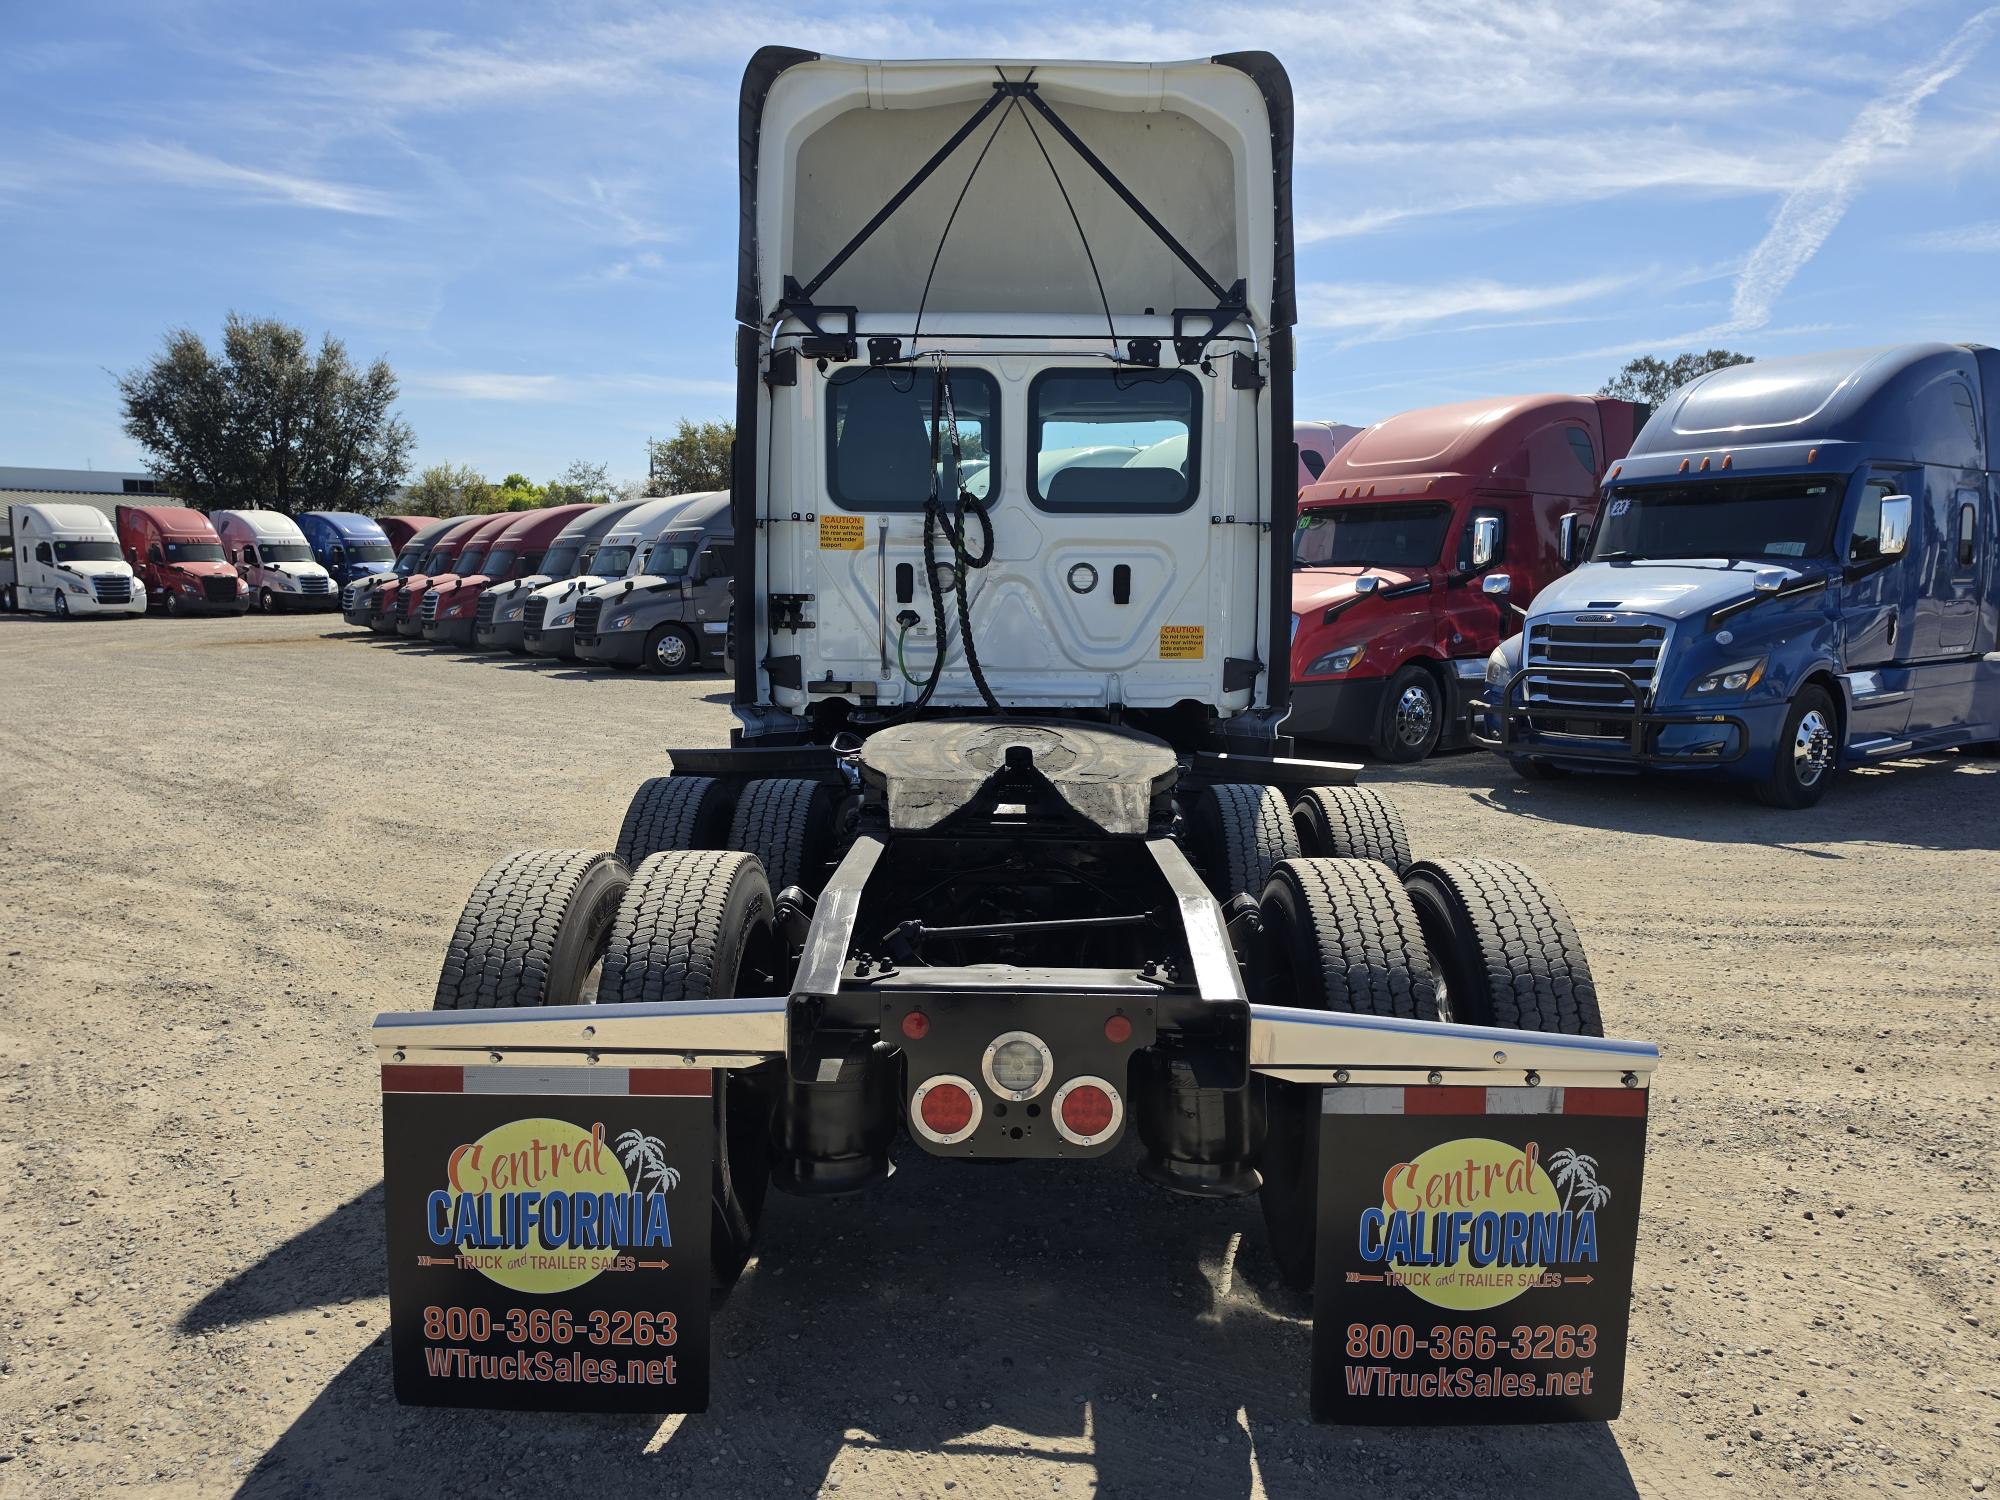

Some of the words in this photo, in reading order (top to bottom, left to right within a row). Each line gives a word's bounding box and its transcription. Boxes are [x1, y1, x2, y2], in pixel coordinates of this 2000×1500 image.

[824, 516, 860, 524] CAUTION
[448, 1122, 607, 1197] Central
[1383, 1141, 1540, 1214] Central
[427, 1190, 672, 1250] CALIFORNIA
[1359, 1207, 1598, 1268] CALIFORNIA
[455, 1254, 503, 1270] TRUCK
[507, 1252, 528, 1271] and
[530, 1255, 587, 1270] TRAILER
[591, 1256, 636, 1272] SALES
[1384, 1271, 1431, 1287] TRUCK
[1435, 1269, 1455, 1287] and
[1458, 1273, 1513, 1287] TRAILER
[1518, 1273, 1562, 1288] SALES
[423, 1306, 678, 1346] 800-366-3263
[1346, 1323, 1598, 1359] 800-366-3263
[424, 1347, 677, 1385] WTruckSales.net
[1345, 1365, 1594, 1397] WTruckSales.net
